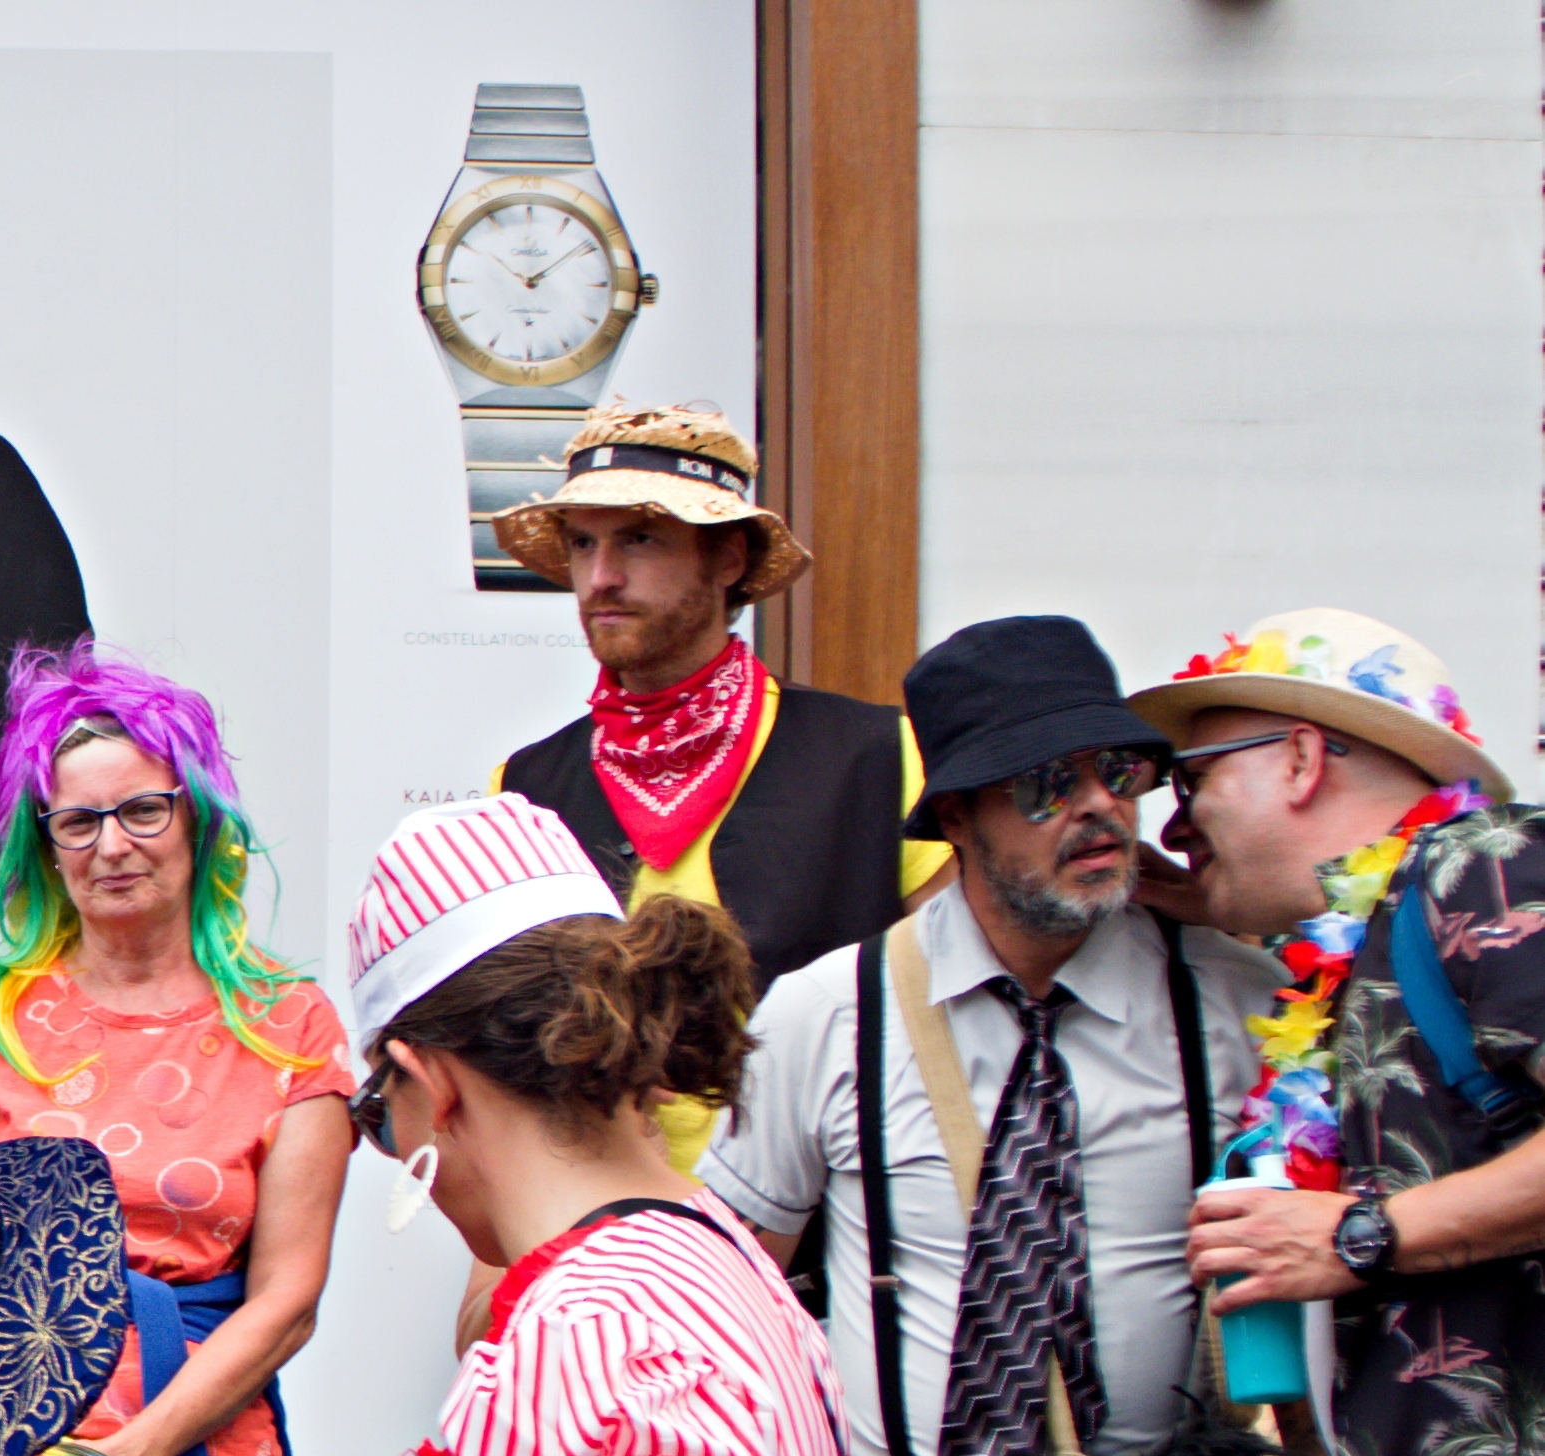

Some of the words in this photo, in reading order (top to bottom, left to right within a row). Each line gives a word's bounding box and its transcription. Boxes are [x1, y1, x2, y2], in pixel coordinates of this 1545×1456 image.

[677, 457, 713, 479] RON
[403, 631, 540, 647] CONSTELLATION
[403, 789, 456, 804] KAIA
